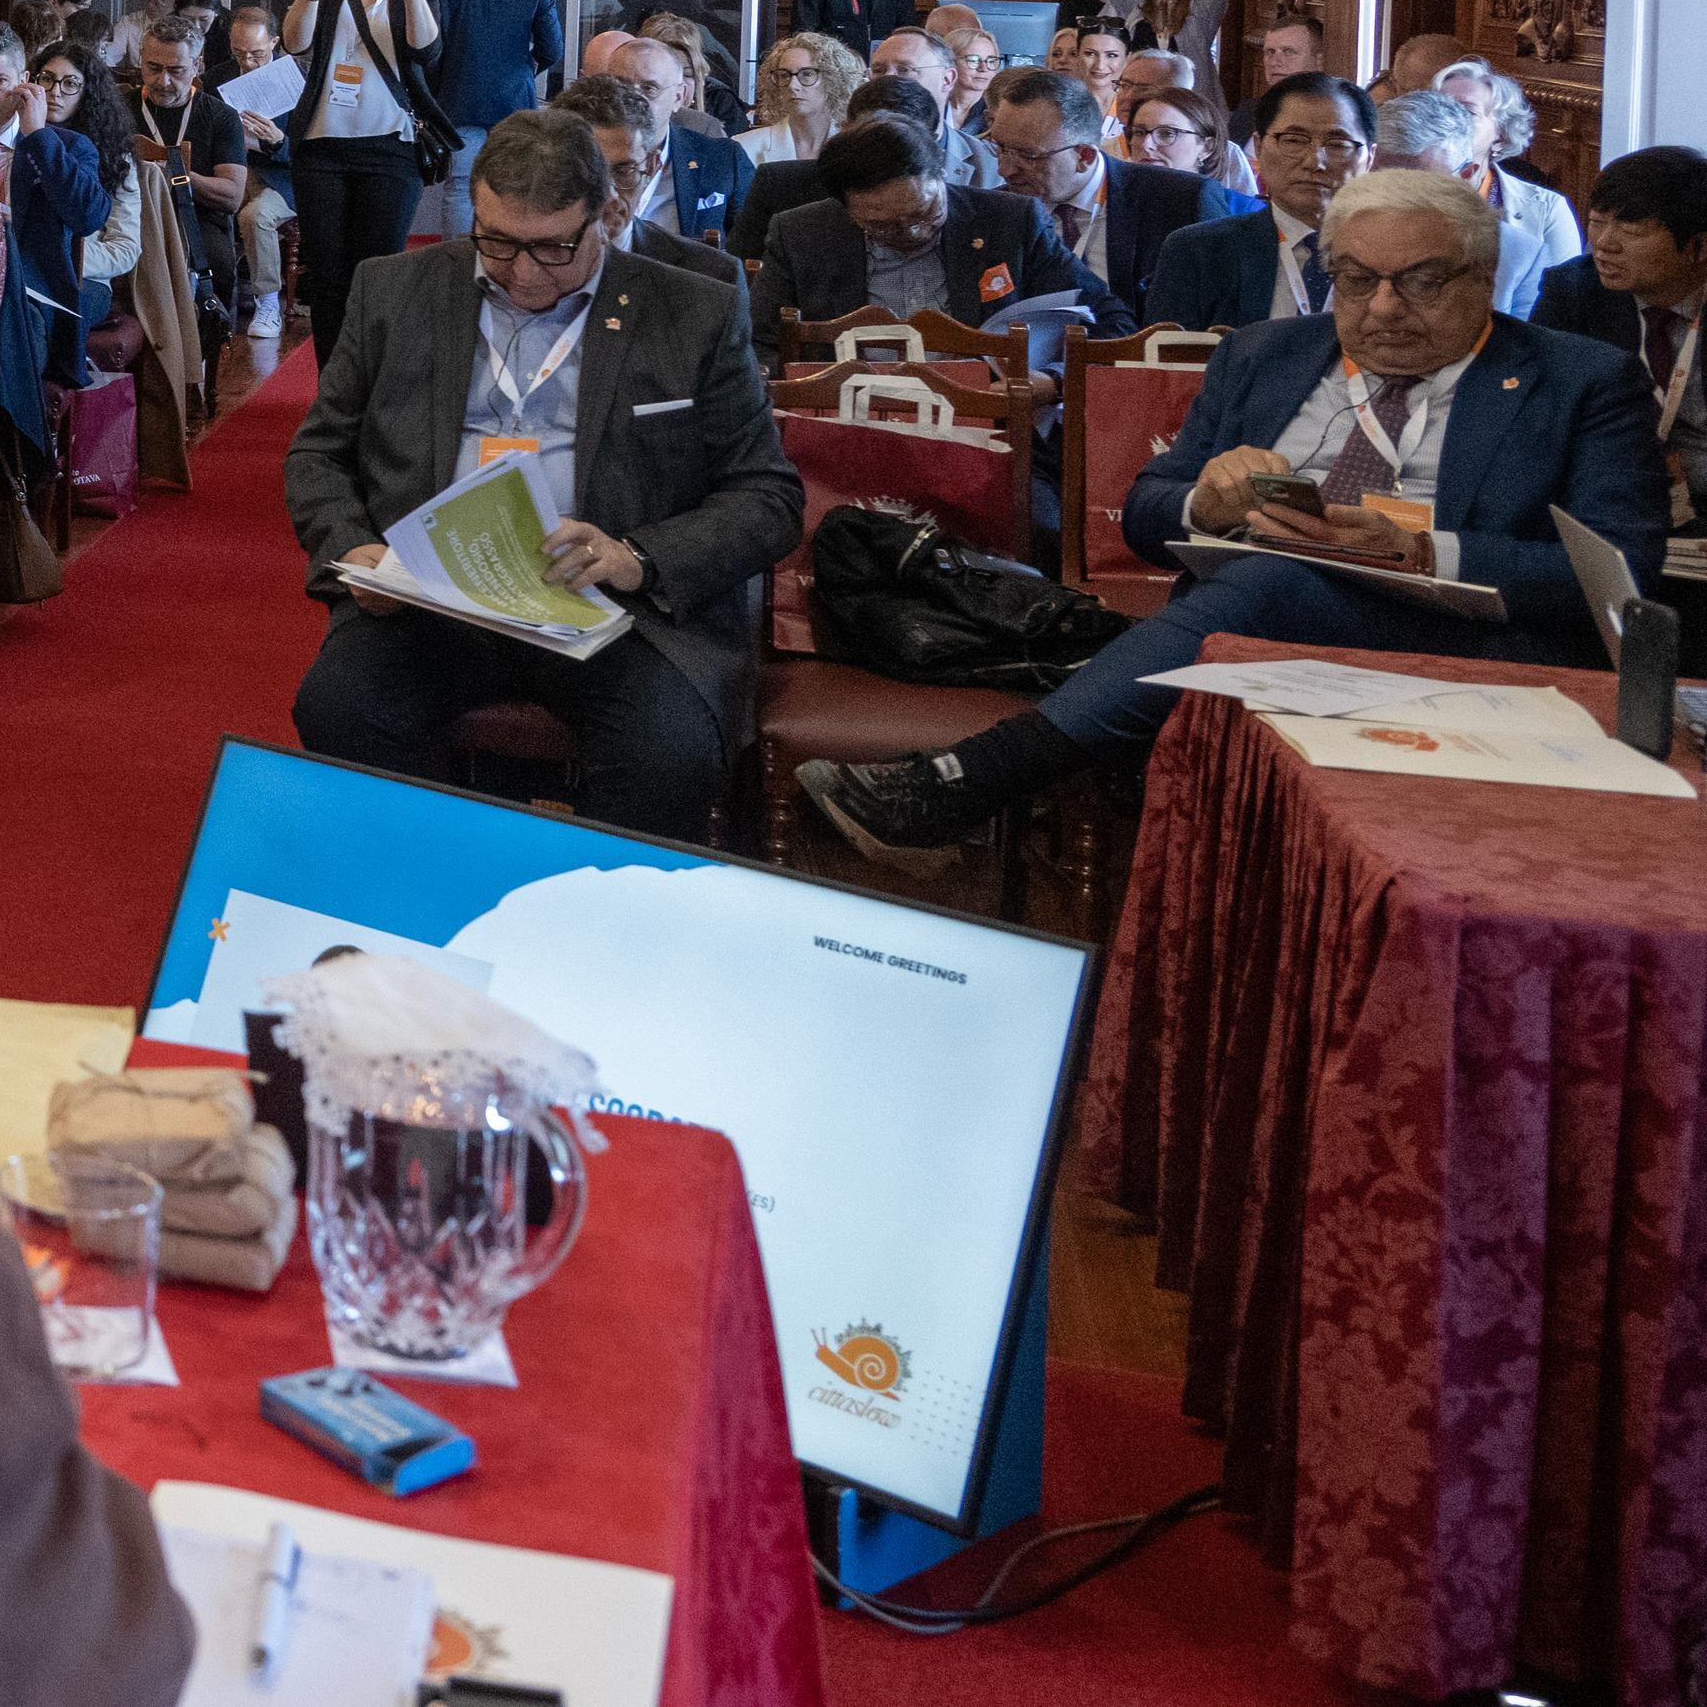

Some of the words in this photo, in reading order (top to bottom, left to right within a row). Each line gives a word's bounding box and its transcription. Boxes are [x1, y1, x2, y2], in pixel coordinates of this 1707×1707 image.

[73, 474, 101, 485] OTAVA
[813, 935, 885, 964] WELCOME
[886, 955, 968, 985] GREETINGS
[808, 1381, 902, 1429] cittaslow
